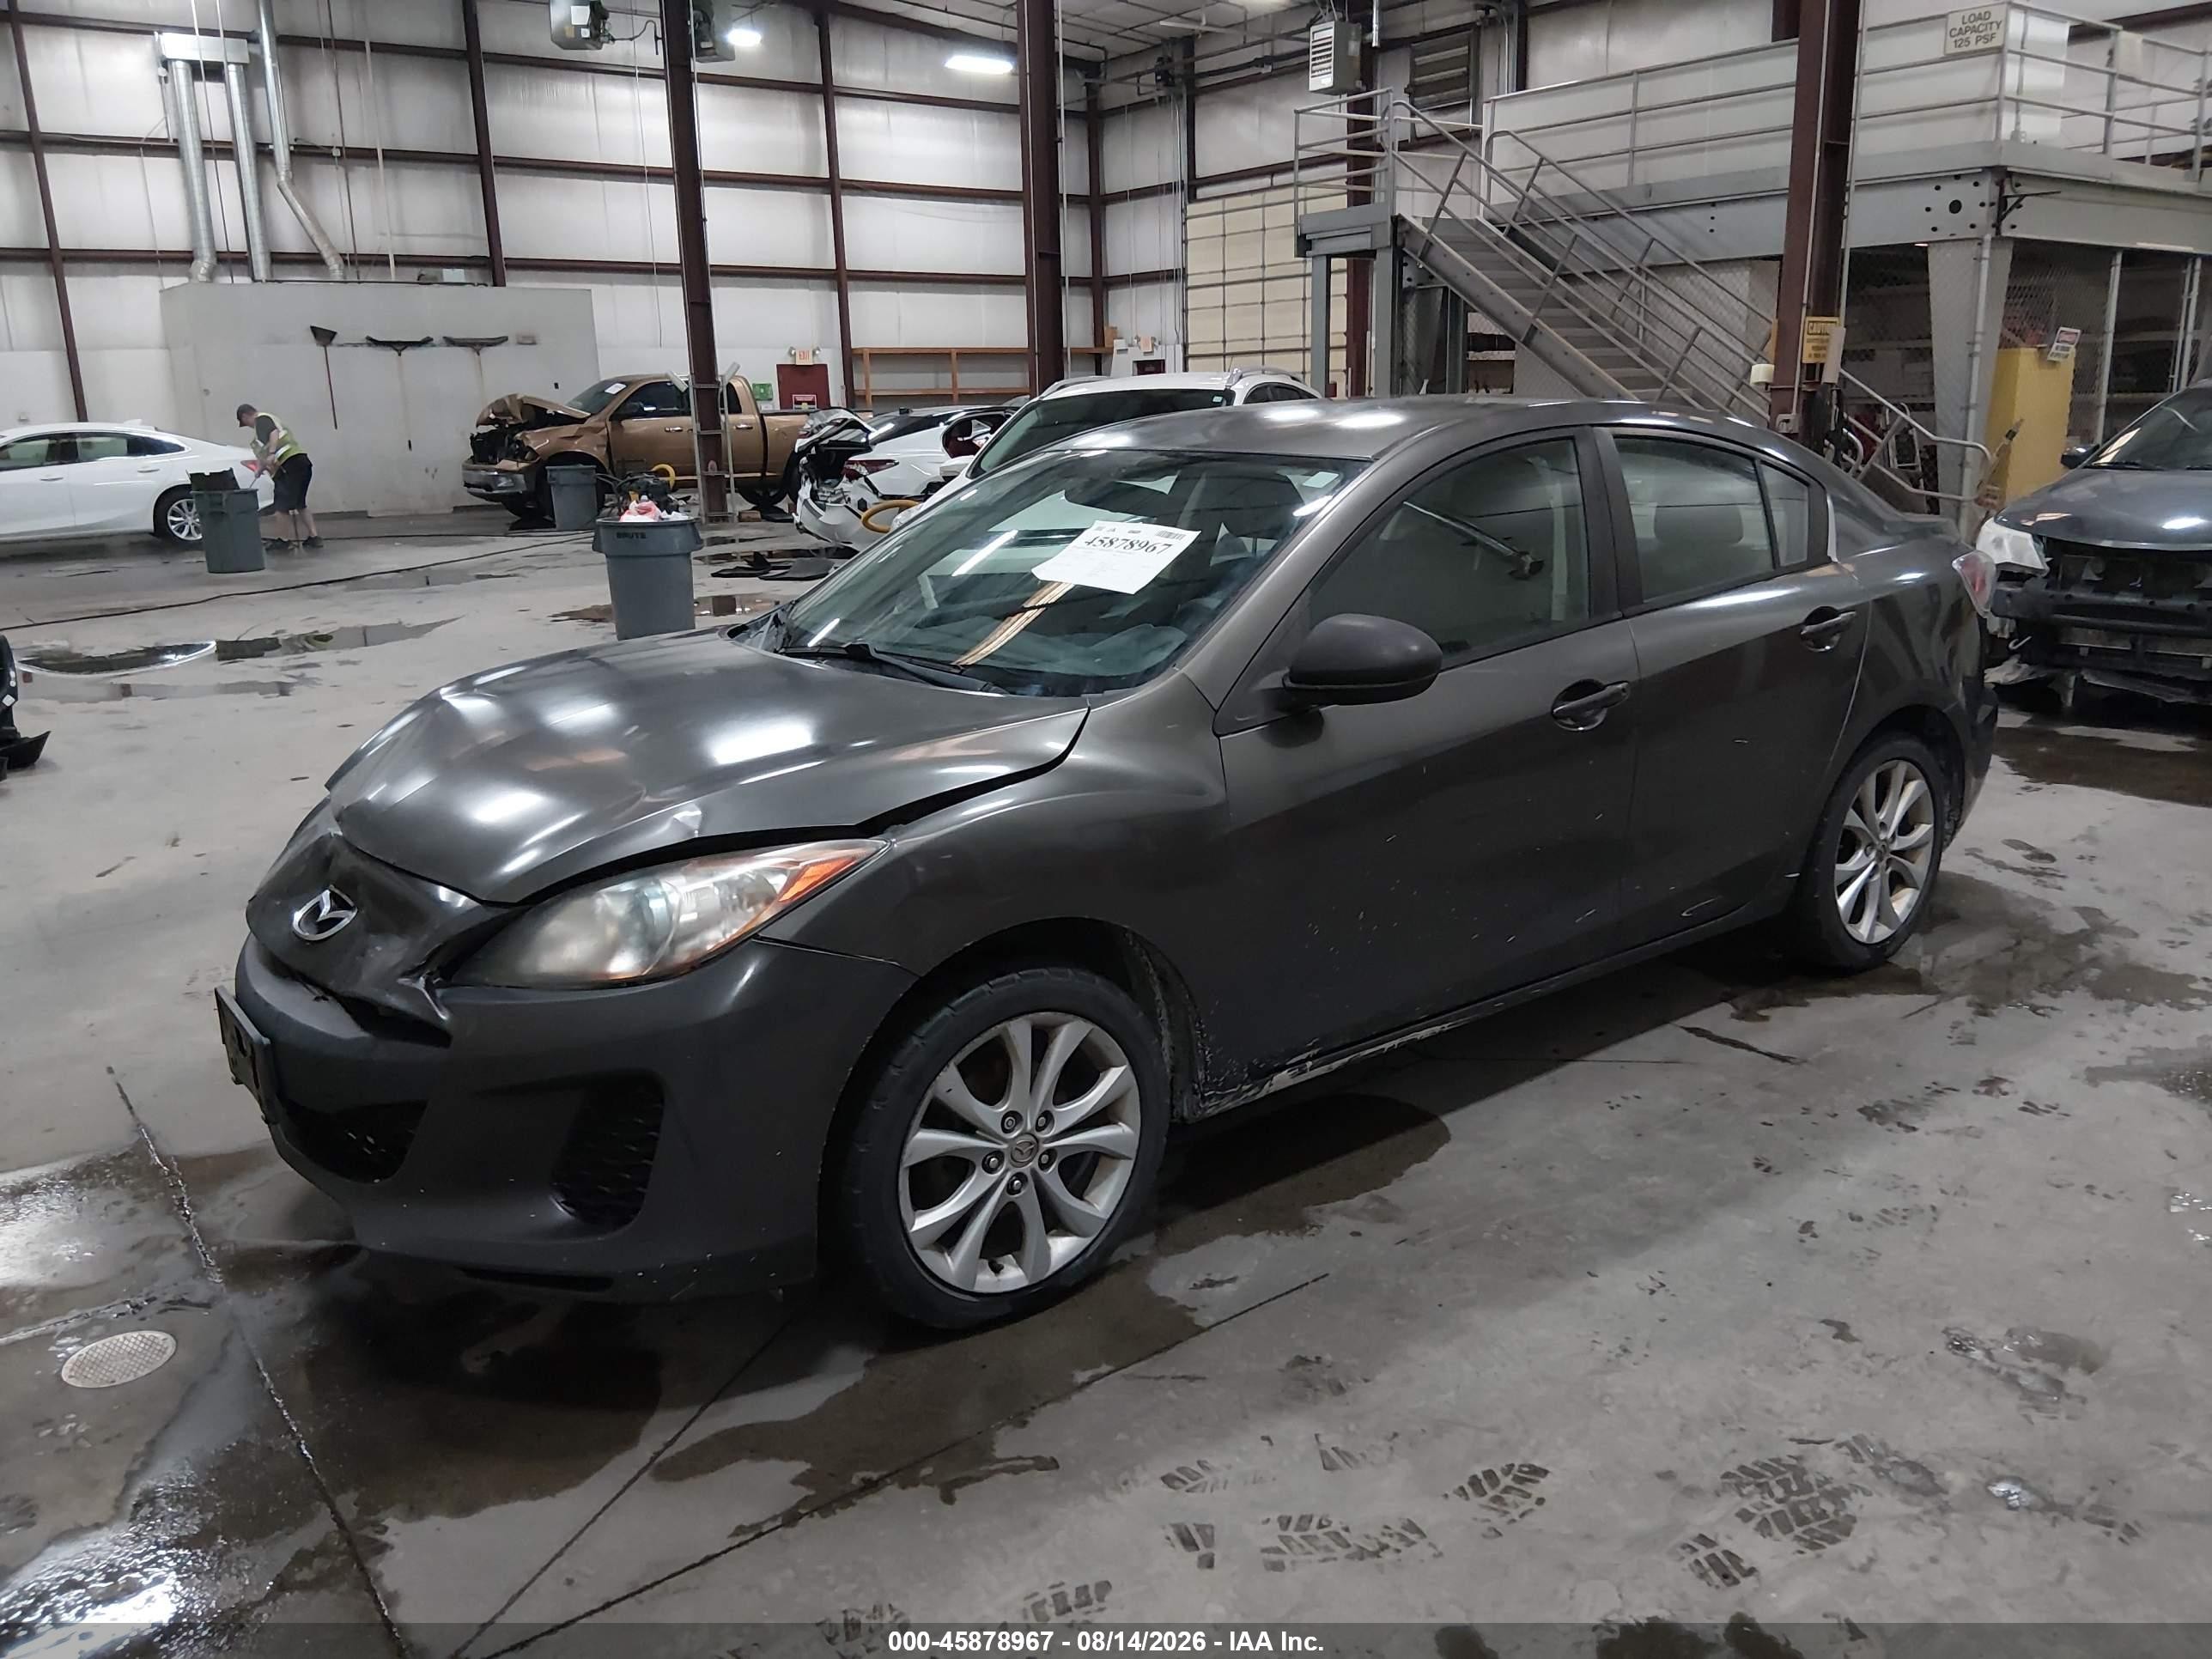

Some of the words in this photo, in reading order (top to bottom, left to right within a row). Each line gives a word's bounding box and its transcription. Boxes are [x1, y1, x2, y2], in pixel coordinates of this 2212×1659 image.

[1961, 10, 1992, 25] LOAD
[1949, 20, 2002, 38] CAPACITY
[1954, 36, 1971, 49] 125
[1975, 32, 1996, 46] PSF
[1085, 535, 1175, 555] 45878967
